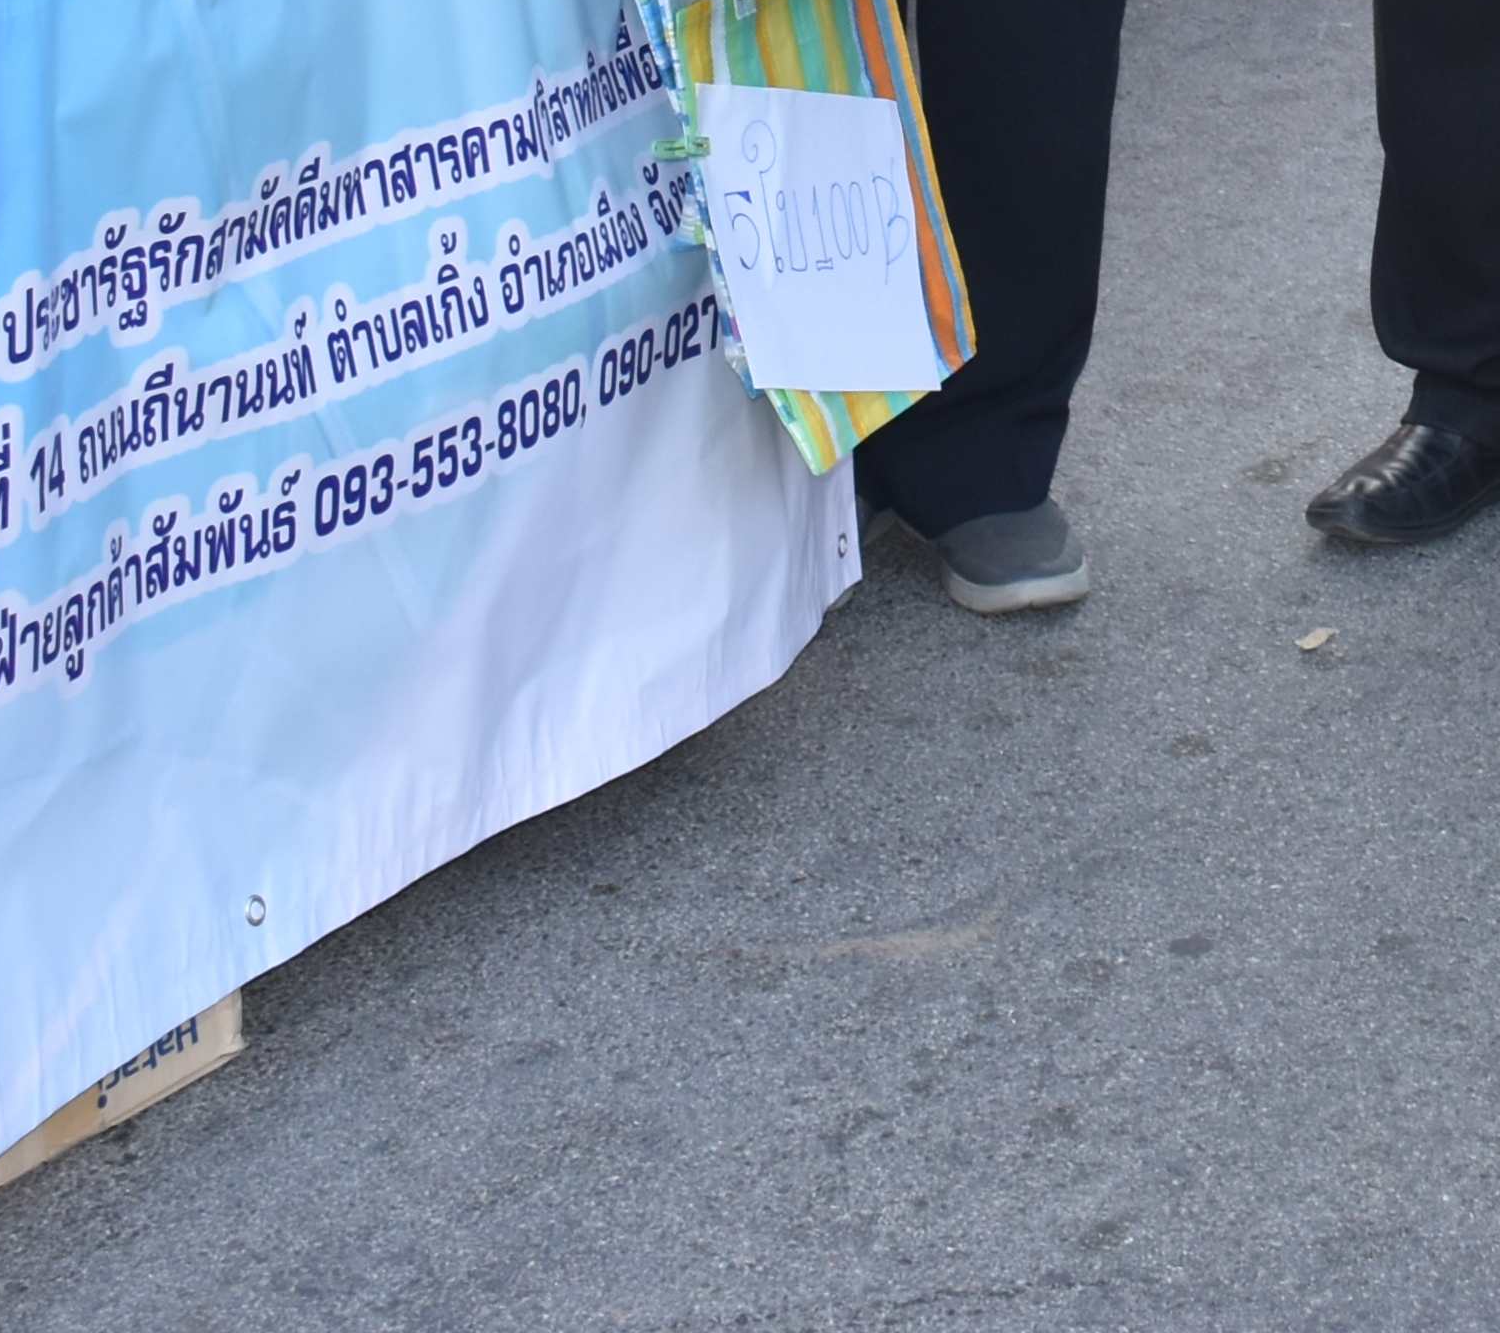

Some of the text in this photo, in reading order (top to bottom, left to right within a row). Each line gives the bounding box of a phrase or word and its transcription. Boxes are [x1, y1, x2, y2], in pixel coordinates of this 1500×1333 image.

[30, 455, 65, 512] 14
[329, 231, 489, 379] ตำบลเกิ้ง
[500, 191, 648, 315] อำเภอเมือง
[599, 294, 722, 410] 090-027
